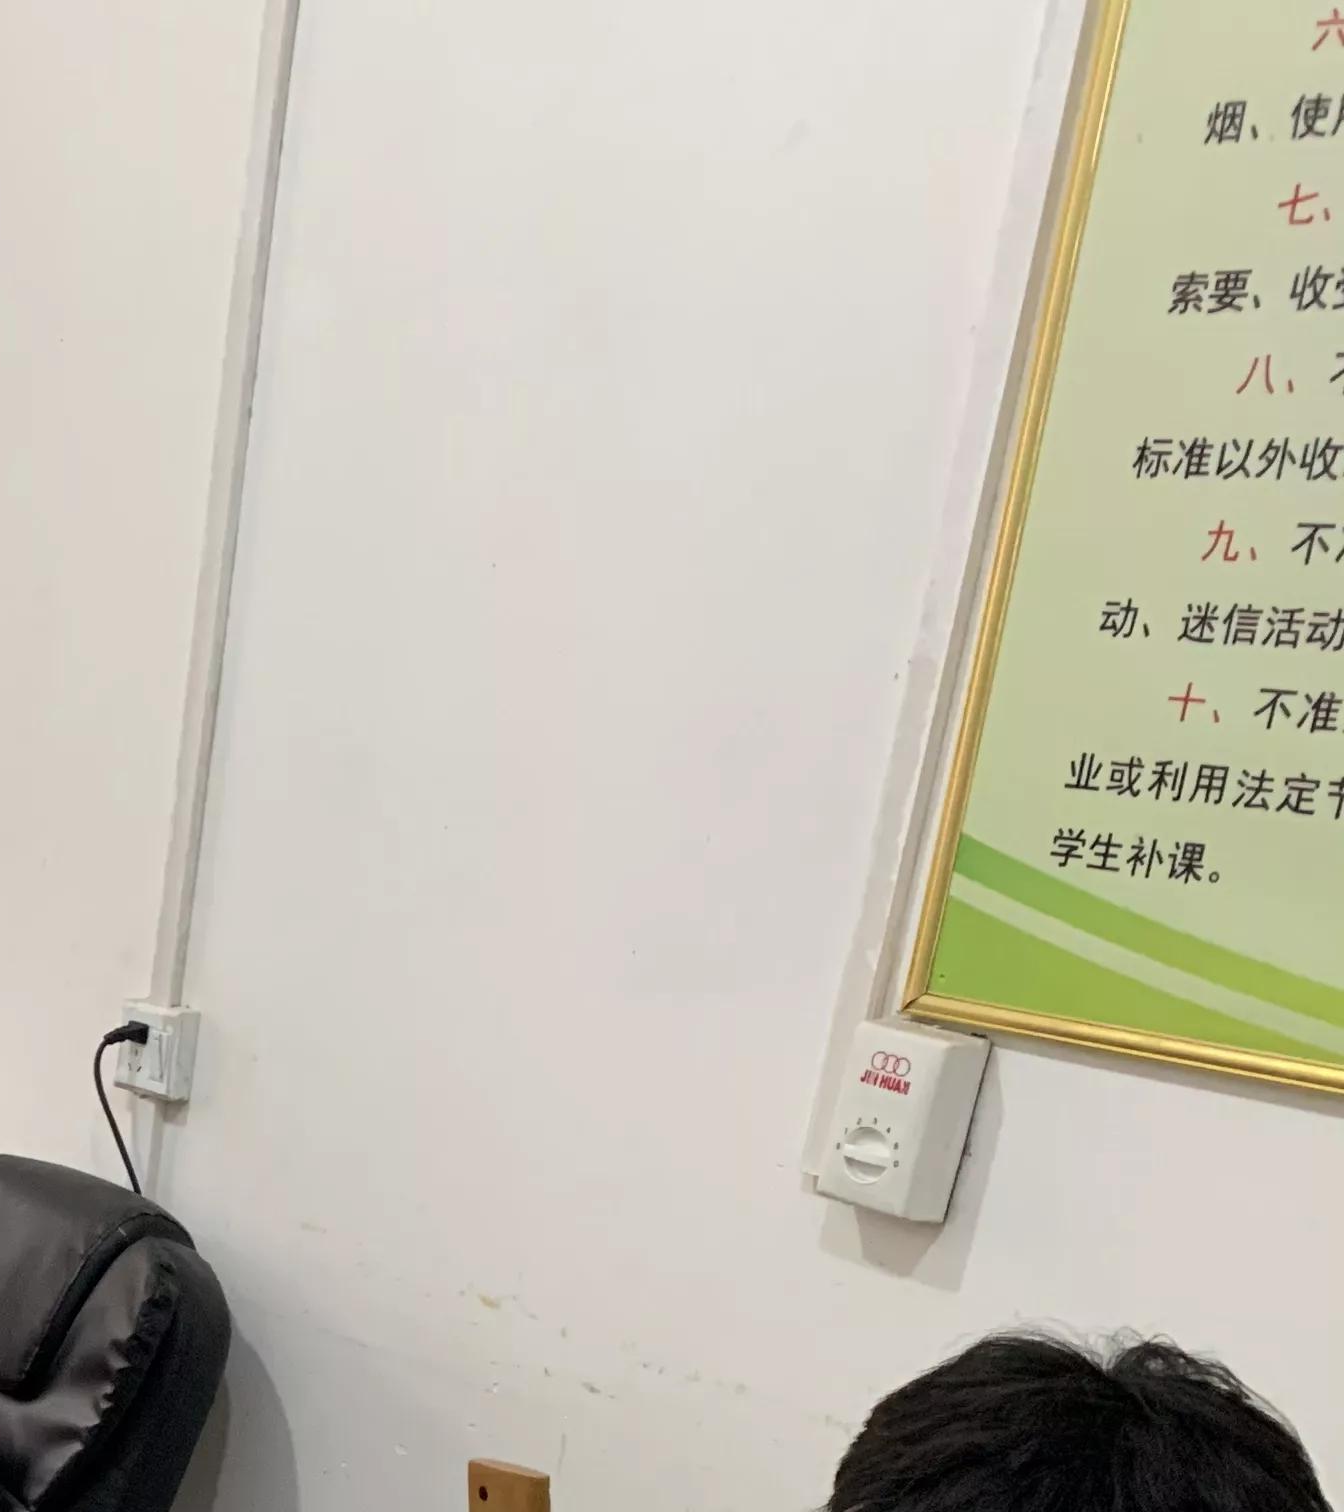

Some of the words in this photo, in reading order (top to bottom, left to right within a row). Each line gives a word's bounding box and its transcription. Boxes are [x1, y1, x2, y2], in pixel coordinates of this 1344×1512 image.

[1203, 94, 1344, 145] 烟、使
[1201, 520, 1344, 566] 九、不
[1099, 598, 1344, 652] 动、迷信活动
[1050, 828, 1223, 885] 学生补课。
